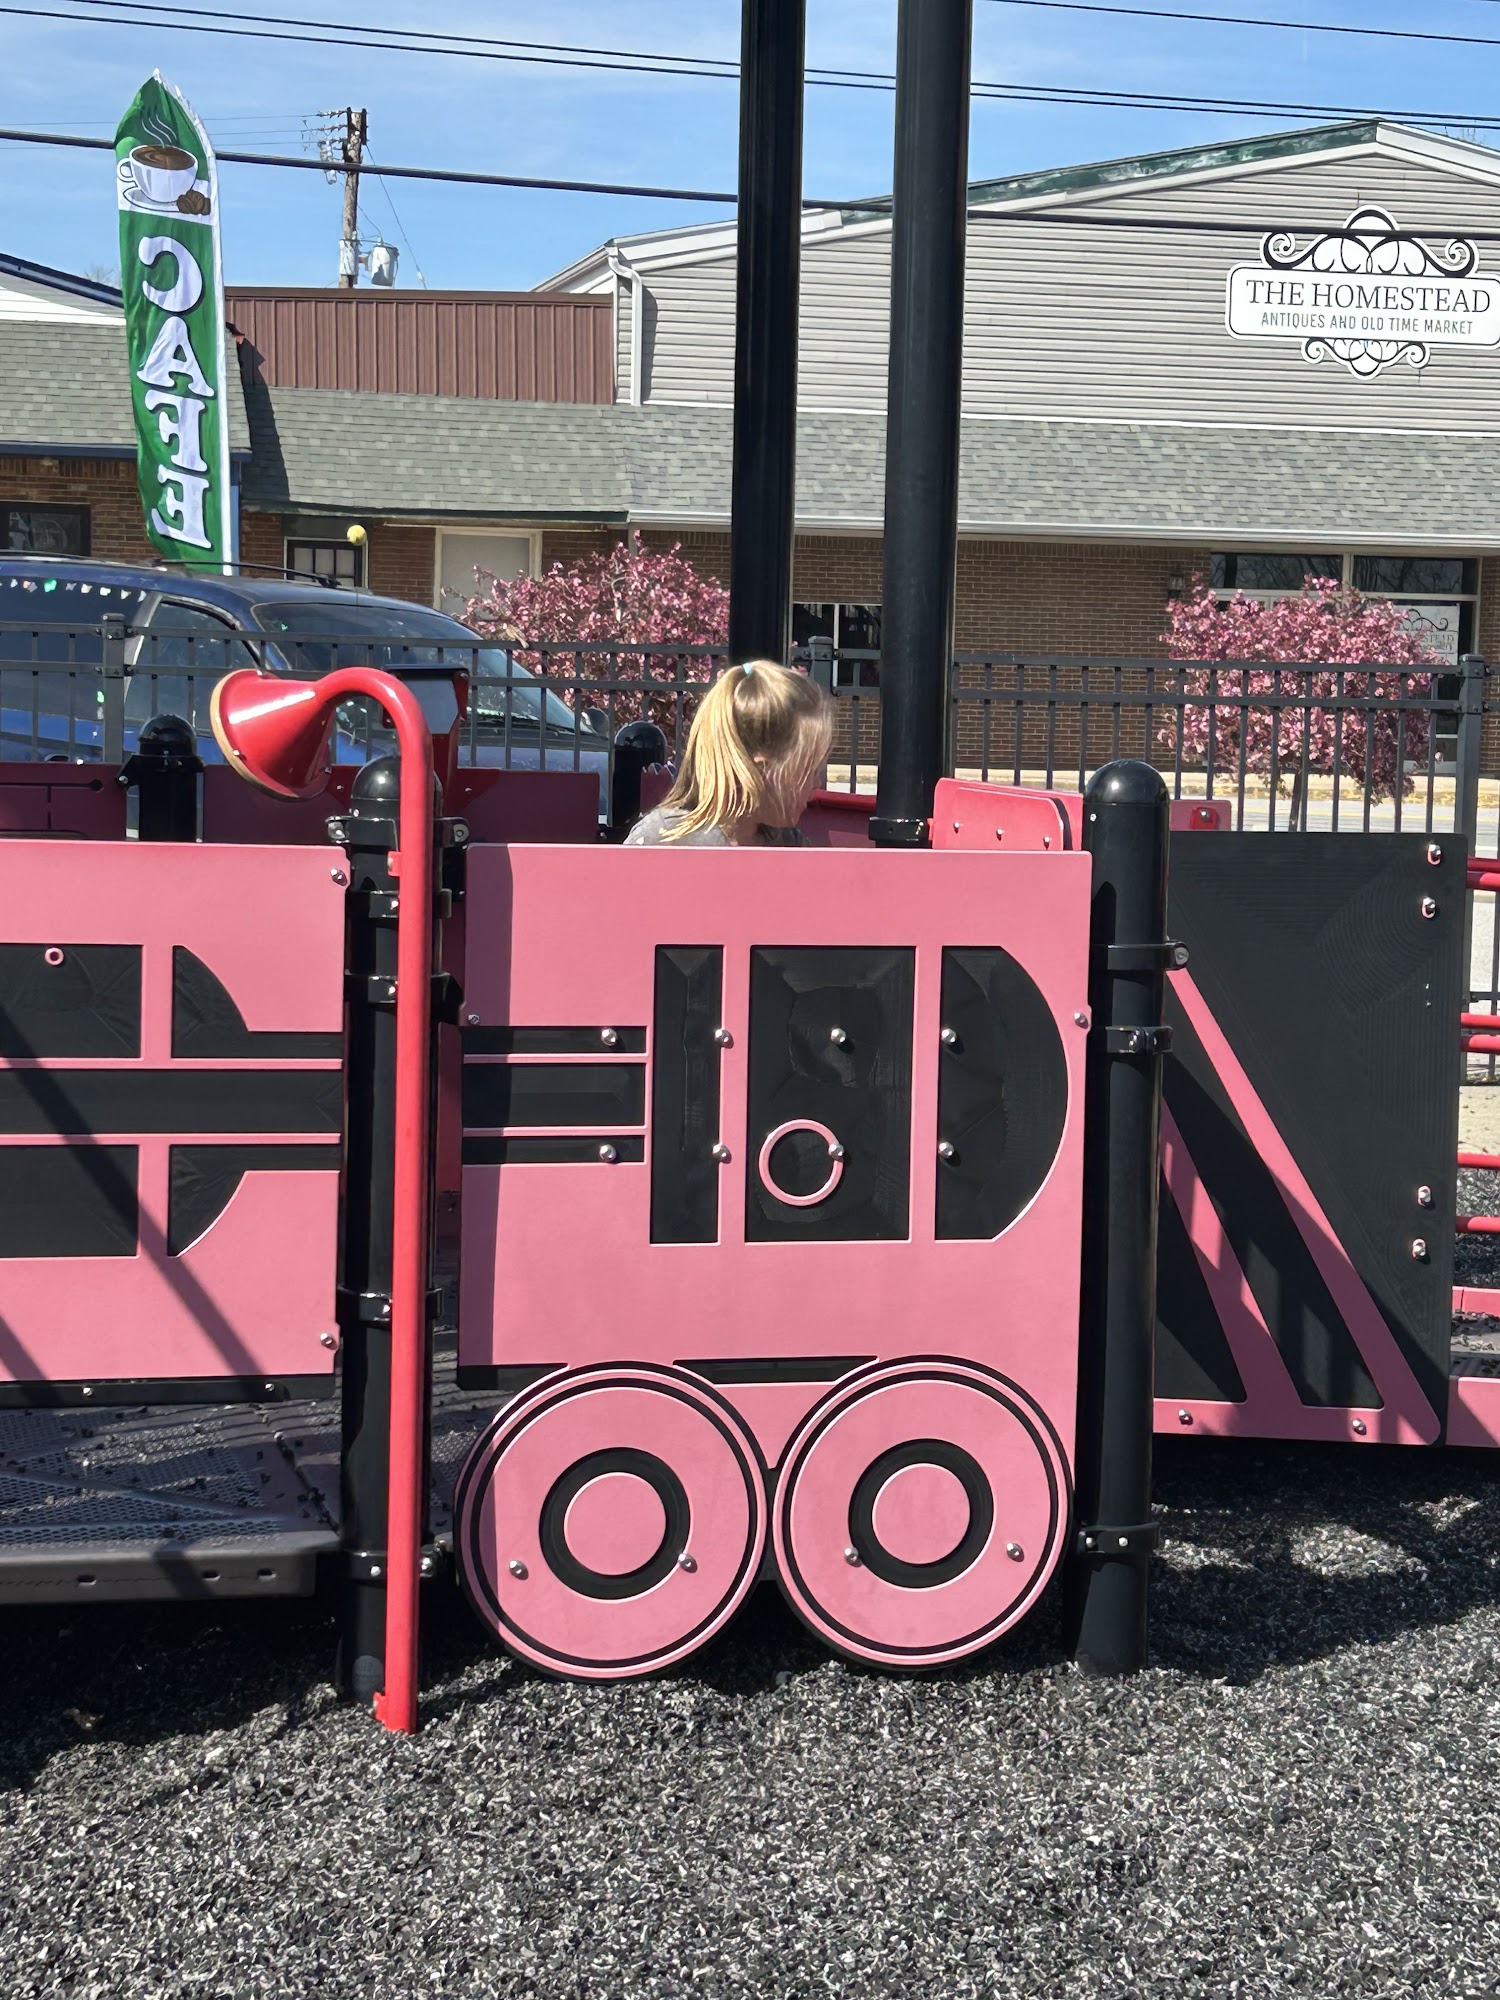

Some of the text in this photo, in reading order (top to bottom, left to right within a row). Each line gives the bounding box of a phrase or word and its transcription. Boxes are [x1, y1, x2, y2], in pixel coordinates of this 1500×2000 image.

[1246, 279, 1491, 313] THE HOMESTEAD
[1261, 311, 1473, 335] ANTIQUES AND OLD TIME MARKET
